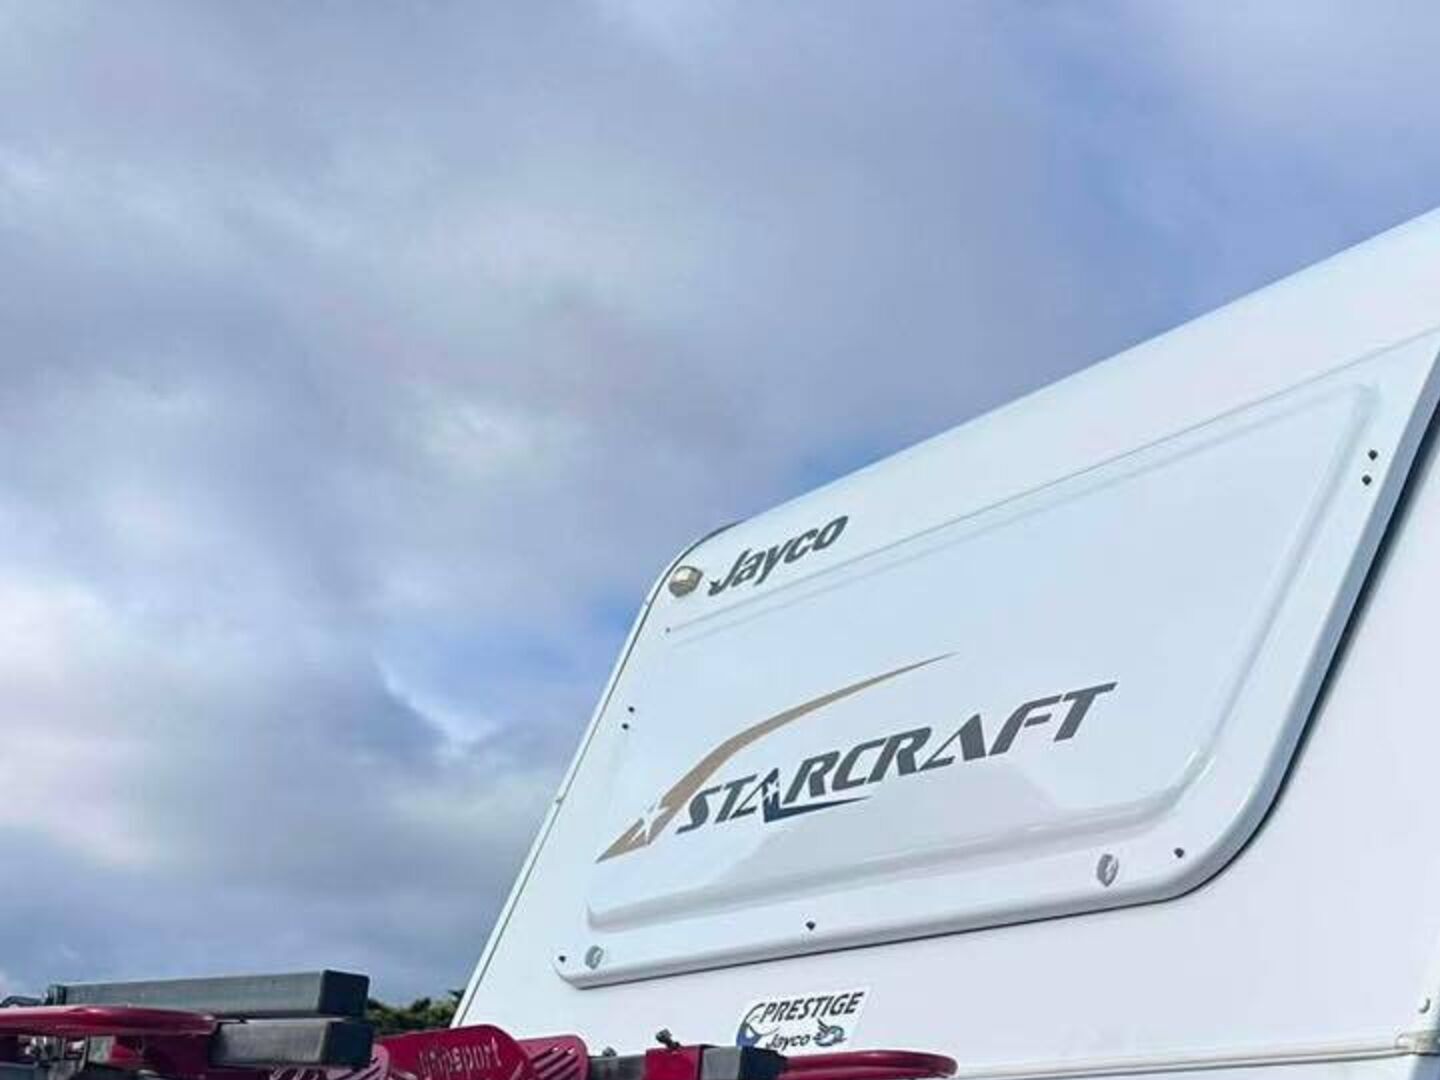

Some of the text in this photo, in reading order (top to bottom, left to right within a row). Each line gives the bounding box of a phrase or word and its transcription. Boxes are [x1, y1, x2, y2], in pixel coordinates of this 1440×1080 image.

[707, 515, 849, 597] Jayco
[675, 681, 1118, 835] STARCRAFT
[758, 991, 865, 1024] PRESTIGE
[766, 1033, 811, 1051] Jayco
